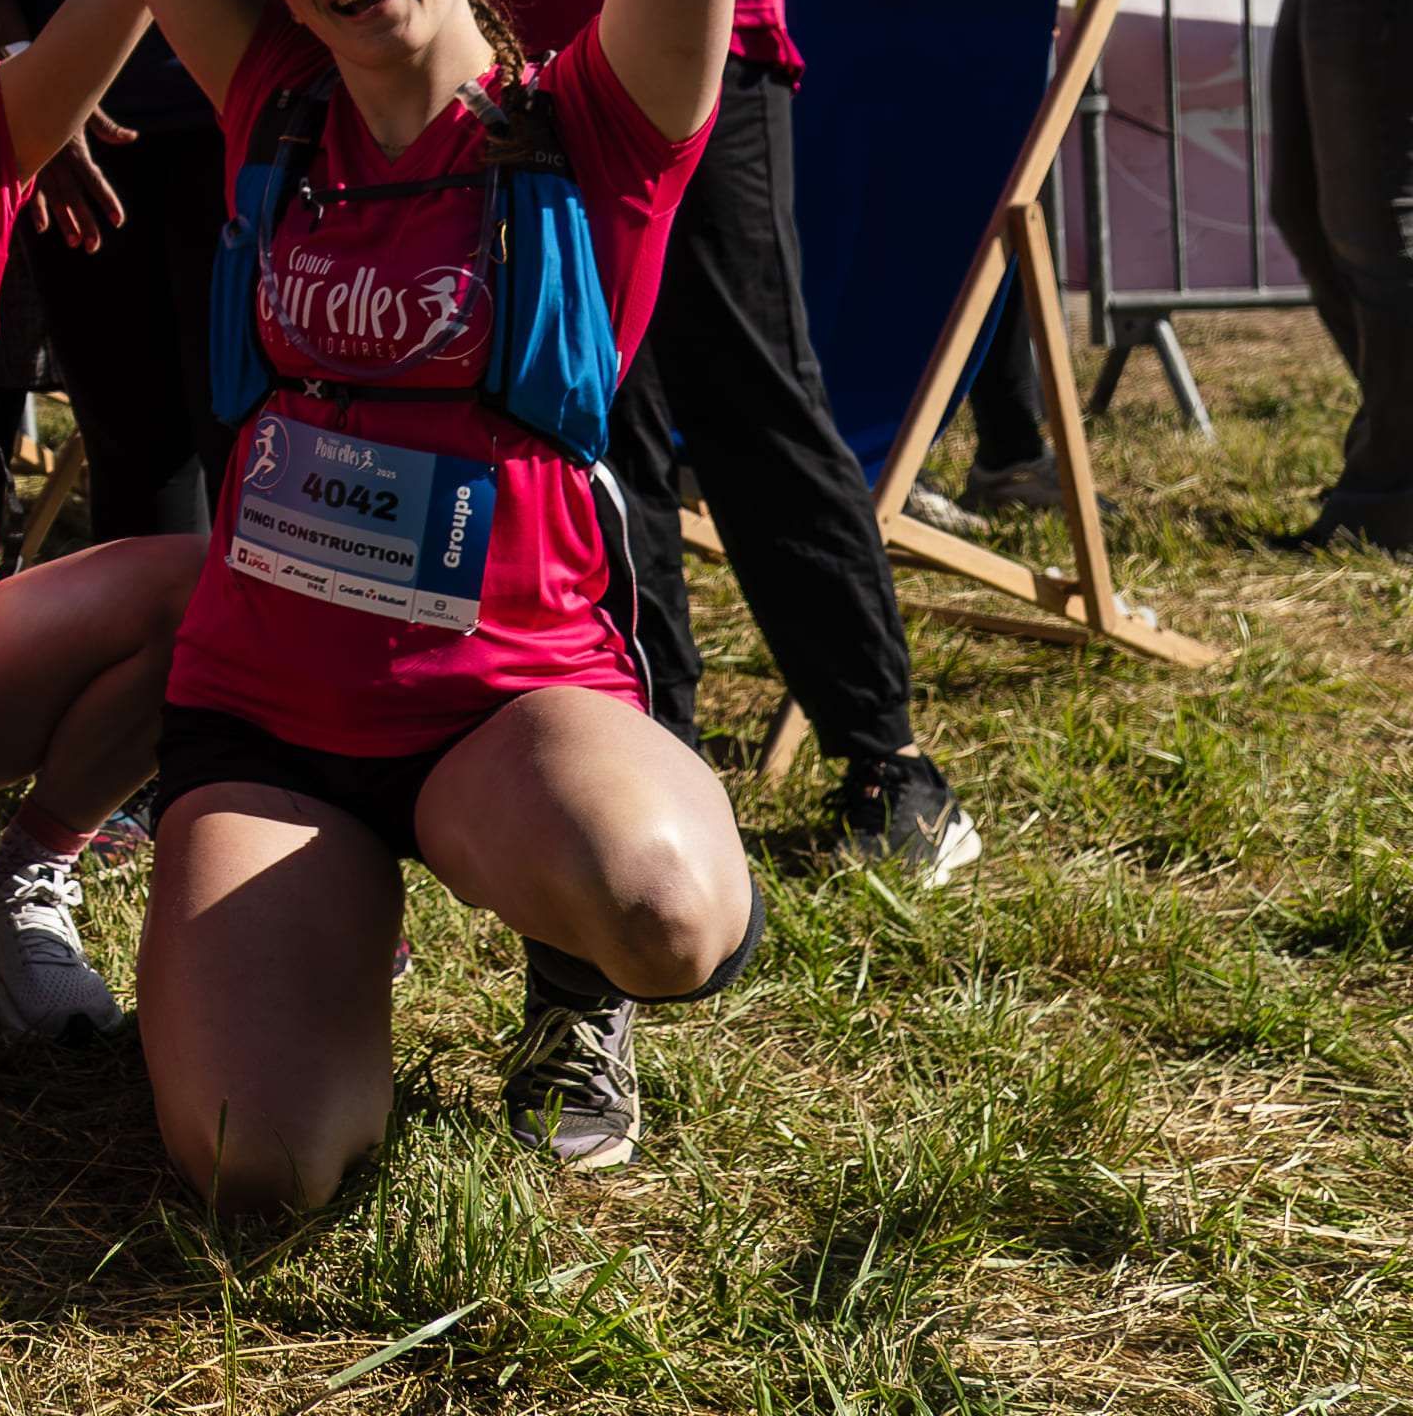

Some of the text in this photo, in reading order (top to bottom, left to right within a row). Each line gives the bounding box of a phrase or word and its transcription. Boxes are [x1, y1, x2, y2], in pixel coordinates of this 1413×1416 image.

[288, 243, 338, 276] Courir
[326, 265, 410, 341] elles
[301, 472, 400, 523] 4042
[243, 506, 415, 568] VINCI CONSTRUCTION
[443, 485, 472, 569] Groupe
[417, 608, 460, 623] FIDUCIAL
